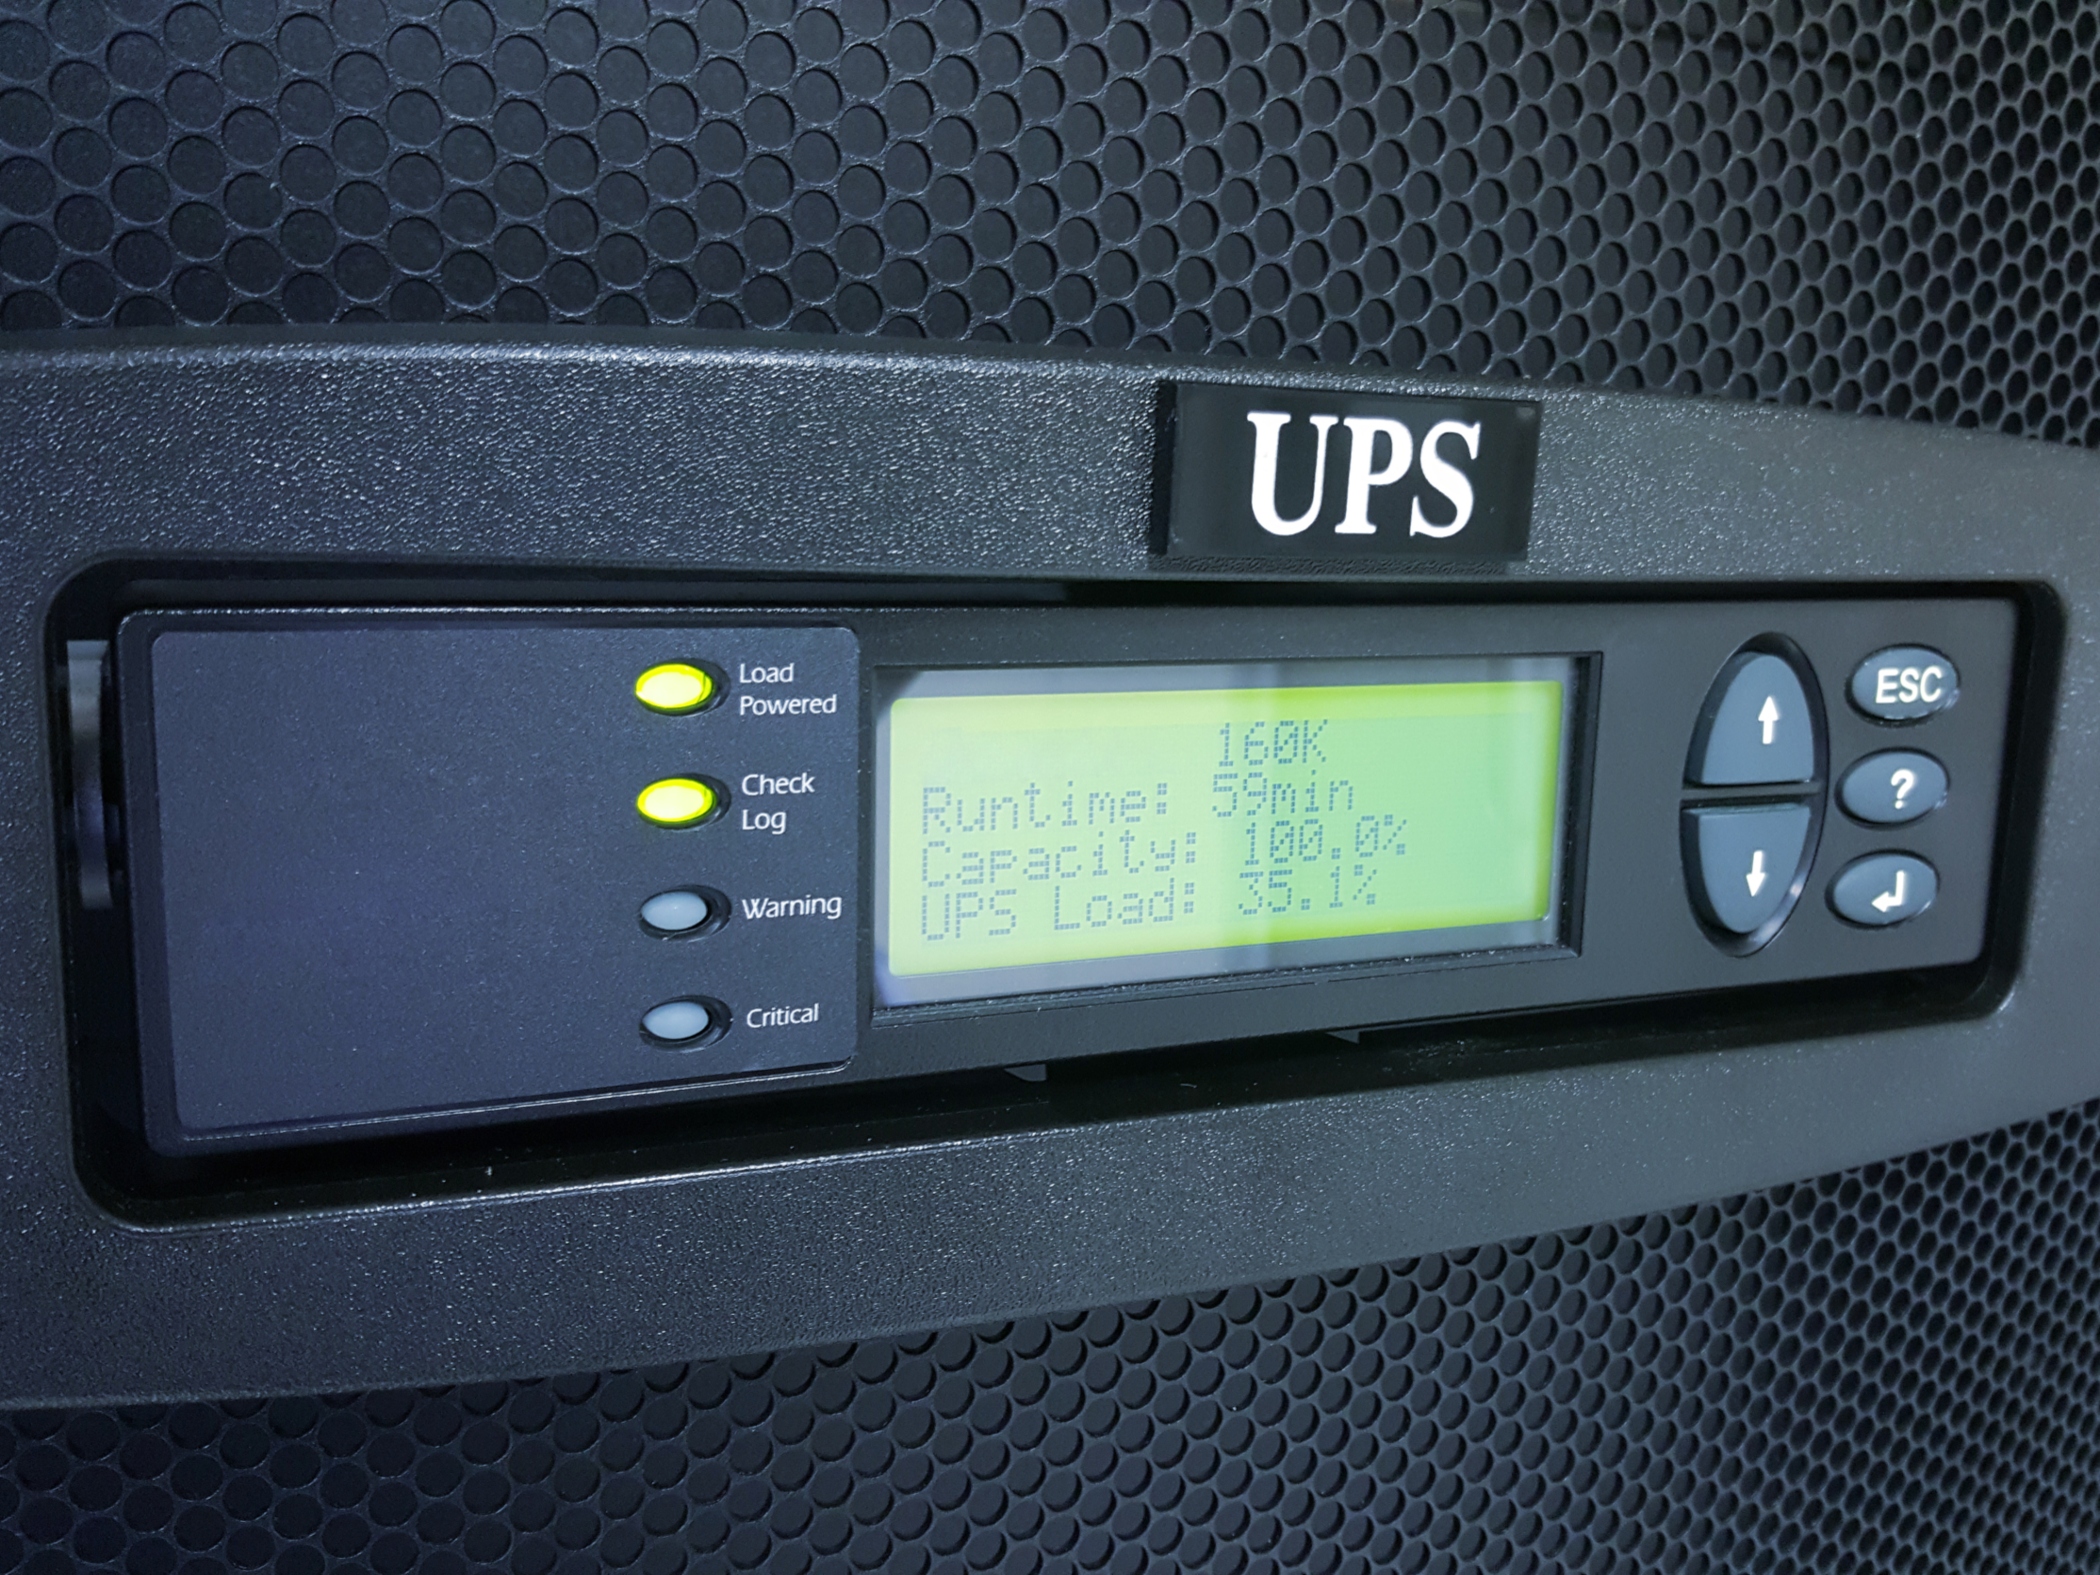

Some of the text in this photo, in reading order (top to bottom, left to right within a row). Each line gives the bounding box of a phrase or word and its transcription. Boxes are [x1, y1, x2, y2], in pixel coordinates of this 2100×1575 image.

[1247, 411, 1481, 538] UPS
[739, 663, 795, 683] Load
[1875, 665, 1944, 703] ESC
[739, 694, 837, 716] Powered
[1219, 719, 1328, 767] 160K
[741, 772, 815, 795] Check
[923, 769, 1354, 834] Runtime: 59min
[1890, 769, 1916, 809] ?
[742, 809, 787, 834] Log
[922, 814, 1407, 887] Capacity: 100.0%
[742, 895, 842, 919] Warning
[922, 864, 1378, 941] UPS Load: 35.1%
[746, 1003, 819, 1029] Critical
